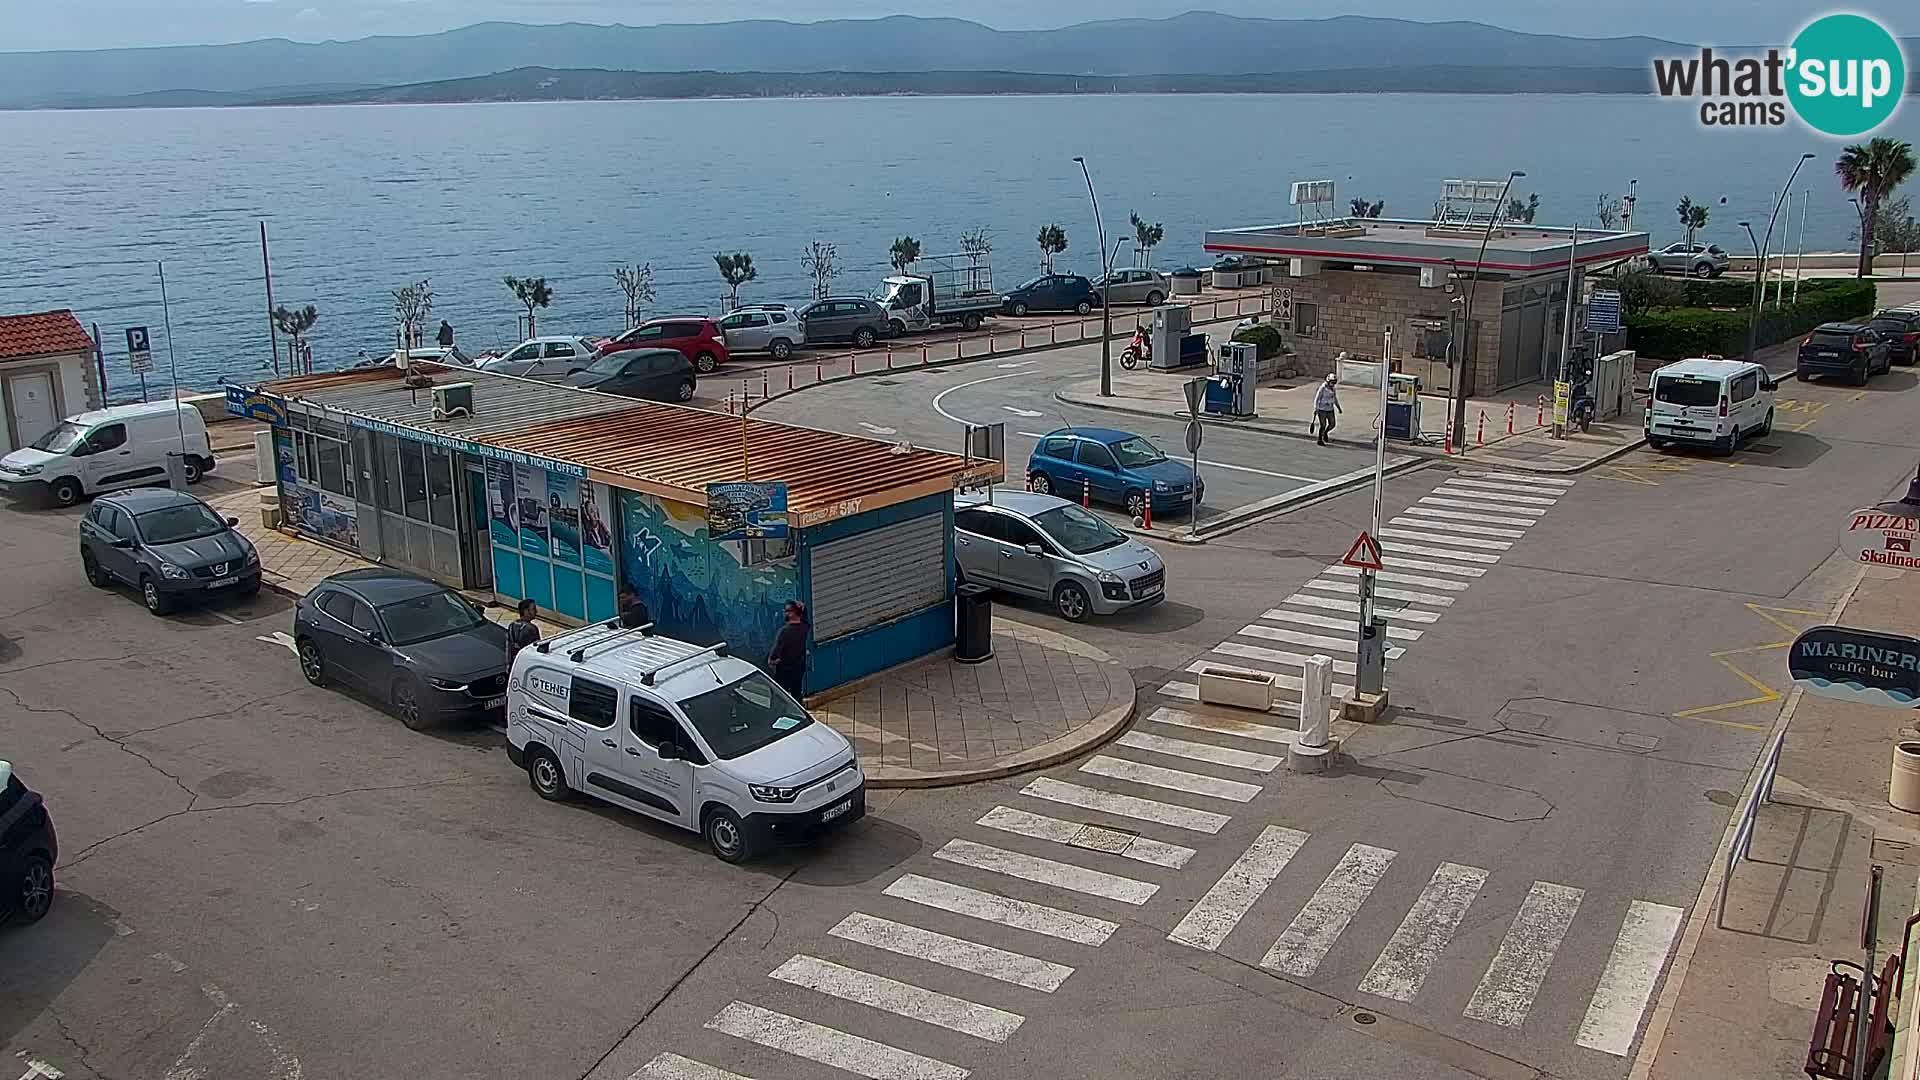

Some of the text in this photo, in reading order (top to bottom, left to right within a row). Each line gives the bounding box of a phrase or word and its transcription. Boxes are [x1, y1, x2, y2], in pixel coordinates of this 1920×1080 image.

[131, 330, 144, 349] P
[398, 426, 437, 445] AUTOBUSNA
[438, 436, 469, 451] POSTAJA
[479, 445, 494, 457] BUS
[495, 448, 527, 465] STATION
[529, 456, 555, 471] TICKET
[556, 462, 584, 477] OFFICE
[839, 499, 862, 517] SKY
[1848, 514, 1920, 533] PIZZE
[1882, 530, 1917, 540] GRILL
[1829, 661, 1897, 679] caffe bar
[540, 679, 570, 698] TEHNET
